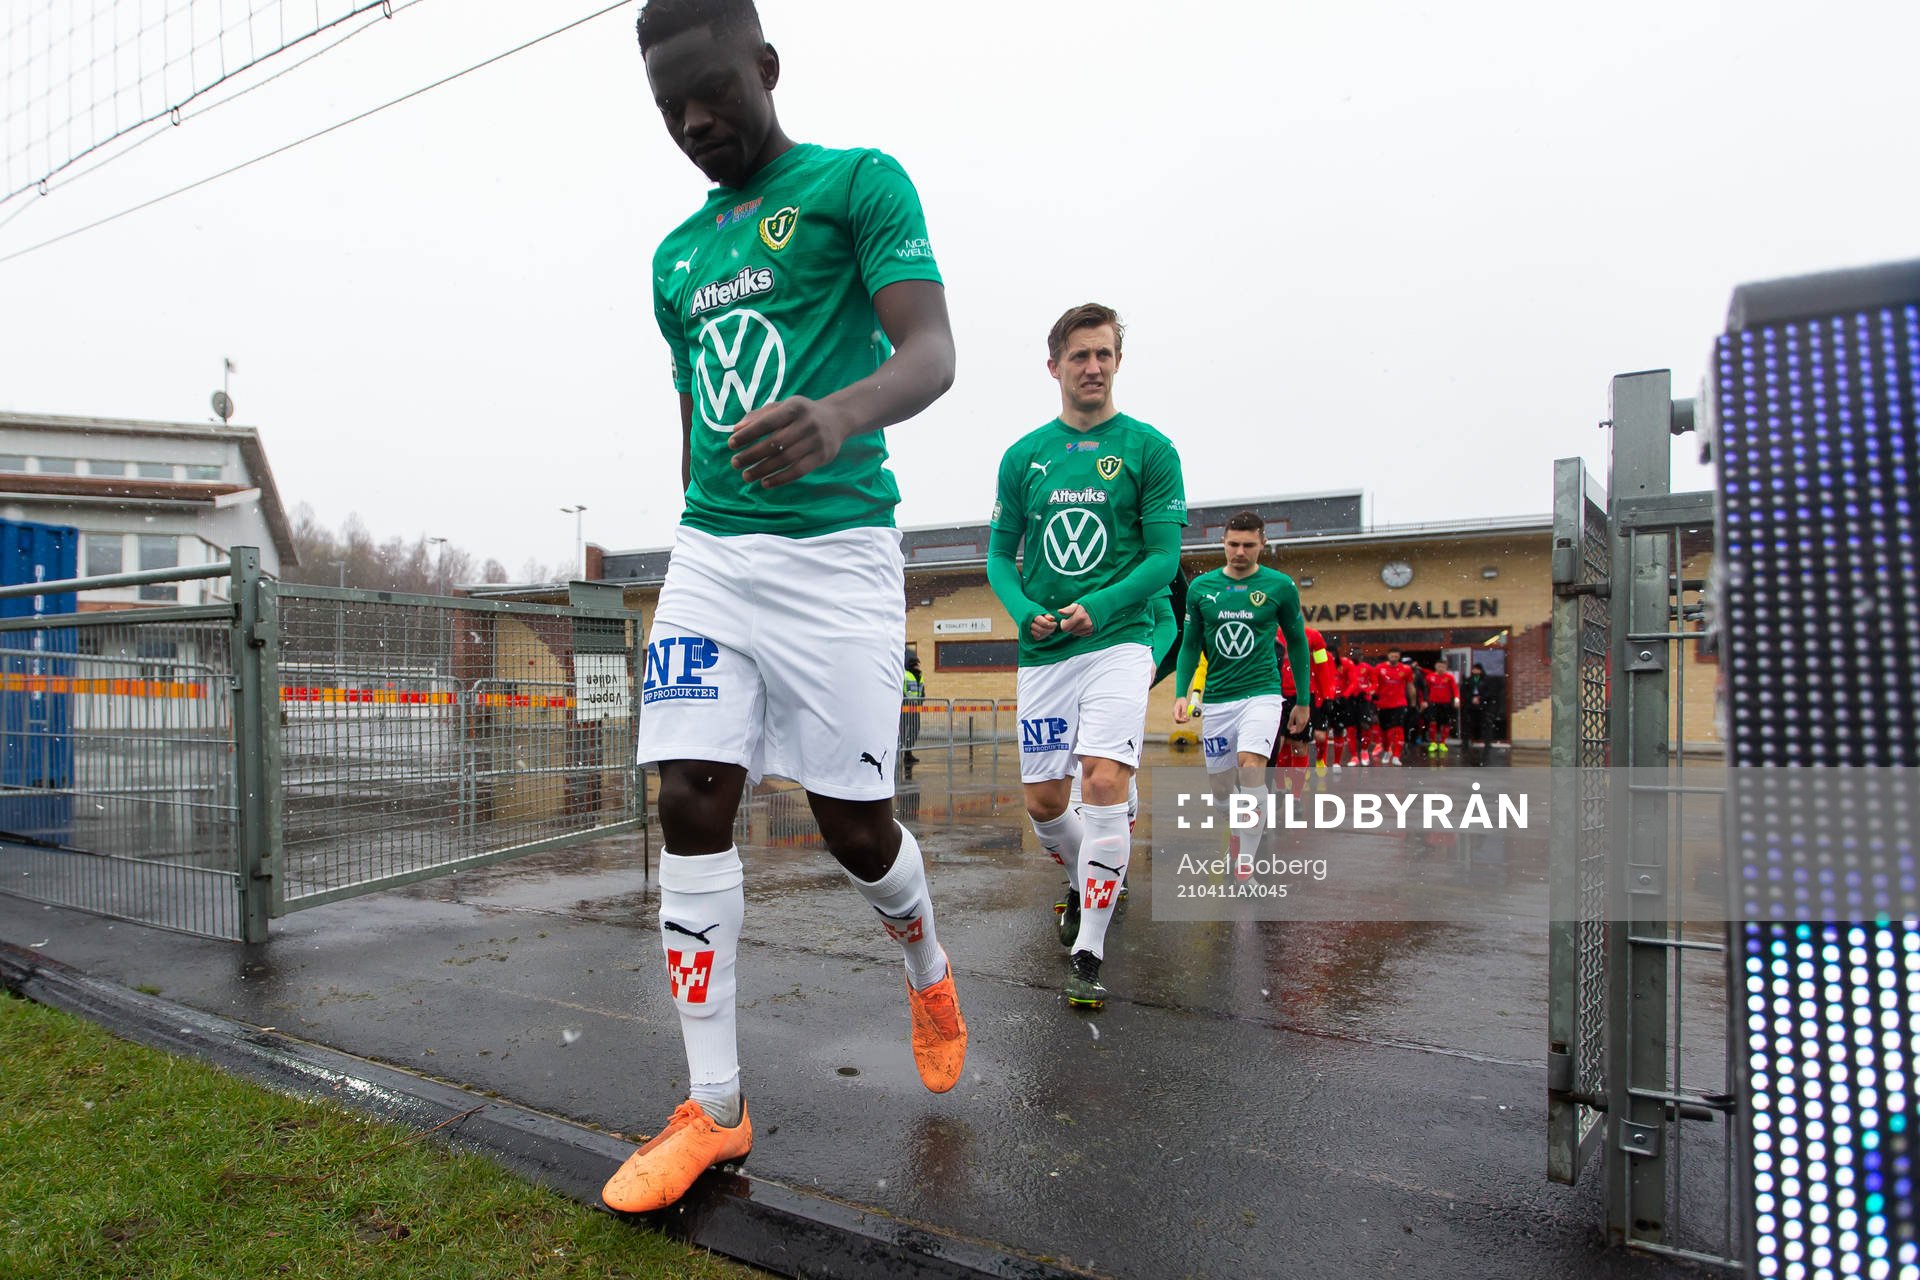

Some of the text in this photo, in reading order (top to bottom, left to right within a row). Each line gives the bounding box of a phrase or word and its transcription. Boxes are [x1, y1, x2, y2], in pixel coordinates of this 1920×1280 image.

[691, 267, 773, 316] Atteviks
[1049, 488, 1106, 503] Atteviks
[1218, 610, 1253, 619] Atteviks
[1302, 598, 1498, 622] VAPENVALLEN
[654, 688, 716, 700] PRODUKTER
